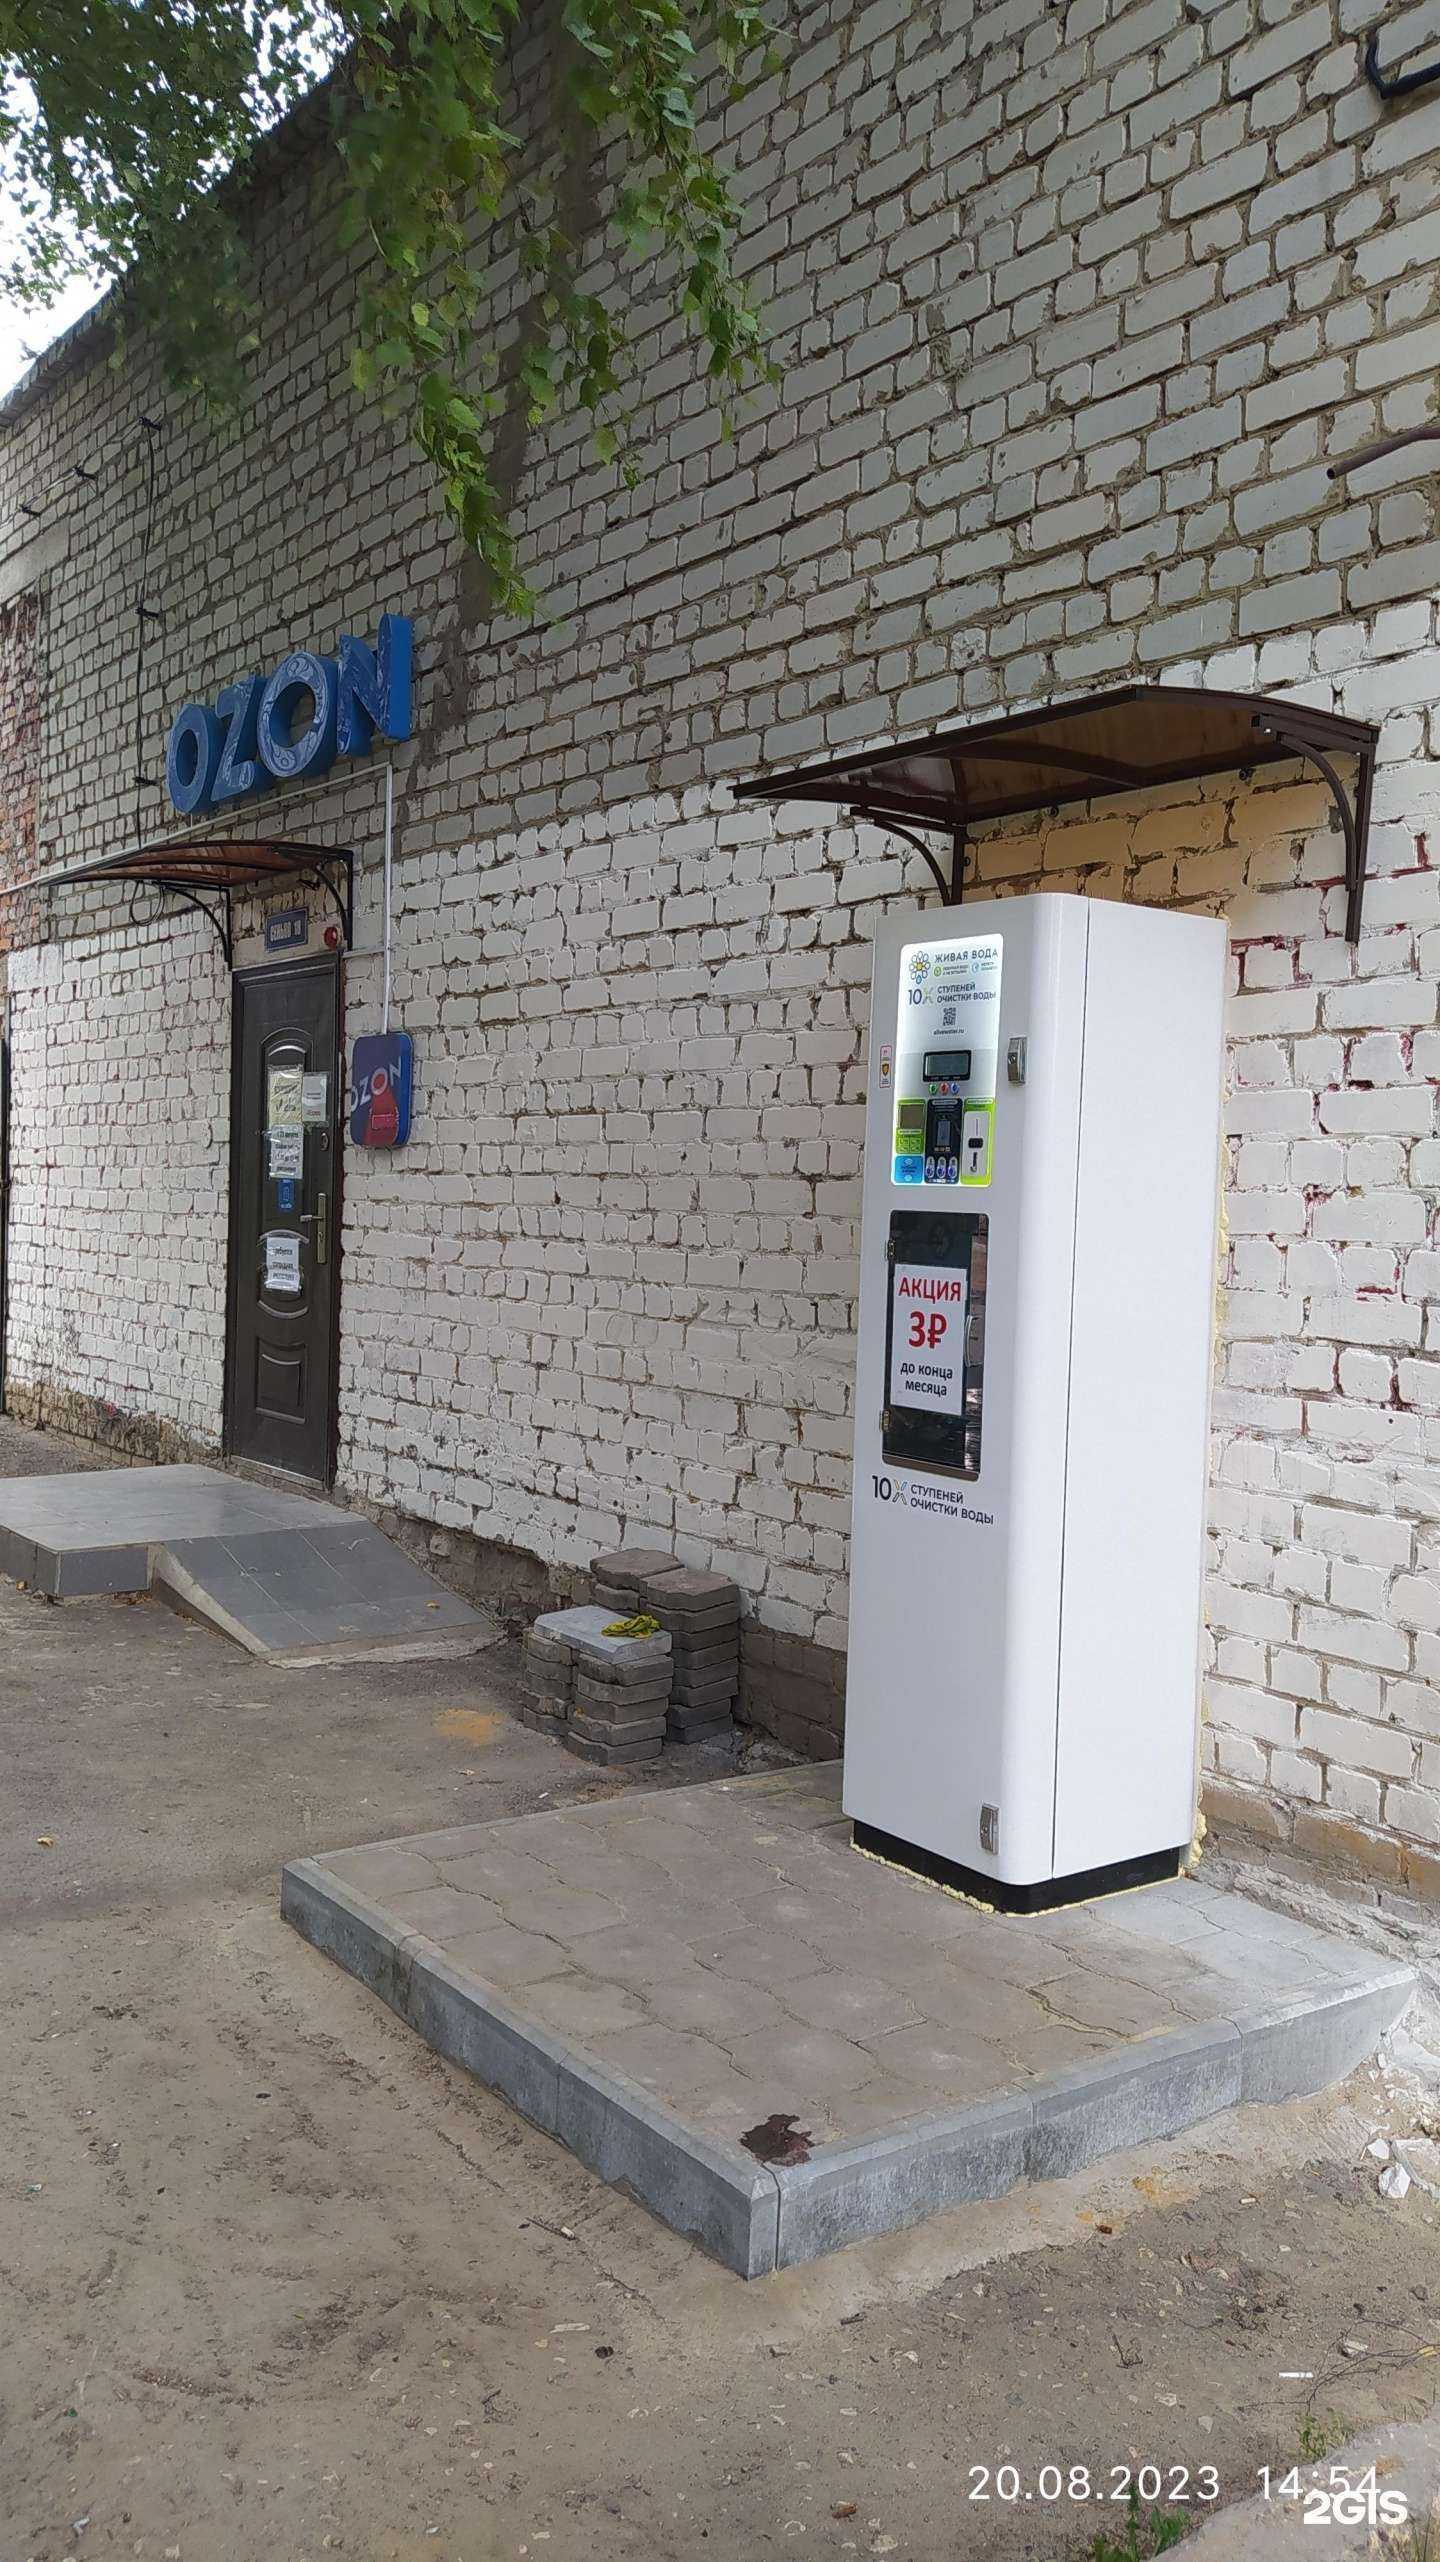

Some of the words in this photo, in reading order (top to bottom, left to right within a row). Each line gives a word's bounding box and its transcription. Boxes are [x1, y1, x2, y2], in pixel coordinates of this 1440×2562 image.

[166, 612, 413, 815] OZON
[935, 951, 969, 963] ЖИВАЯ
[971, 948, 998, 960] ВОДА
[936, 993, 972, 1004] ОЧИСТКИ
[973, 991, 996, 1001] ВОДЫ
[937, 982, 976, 994] СТУПЕНЕЙ
[898, 1276, 961, 1304] АКЦИЯ
[900, 1362, 916, 1376] до
[918, 1364, 953, 1381] конца
[905, 1380, 947, 1398] месяца
[910, 1484, 964, 1504] СТУПЕНЕЙ
[910, 1497, 958, 1517] ОЧИСТКИ
[960, 1508, 994, 1525] ВОДЫ
